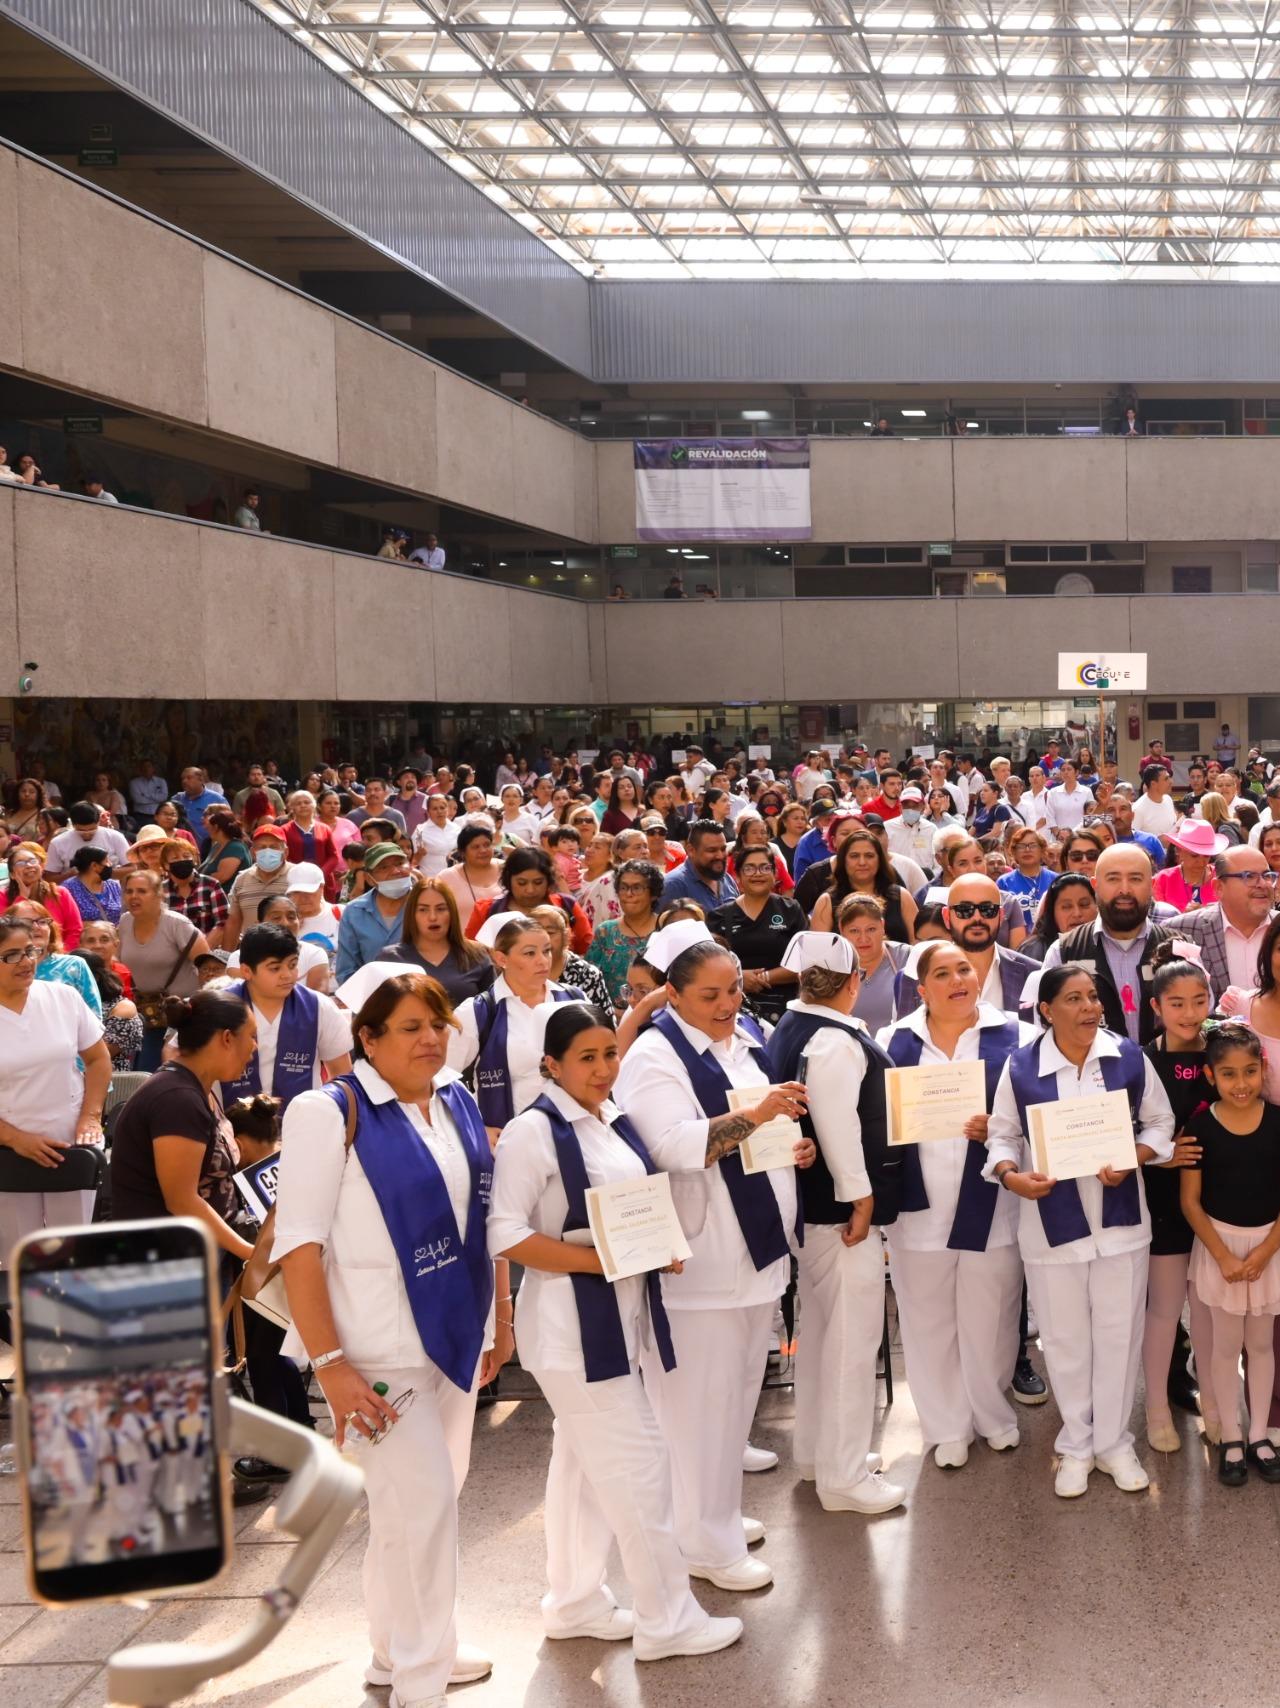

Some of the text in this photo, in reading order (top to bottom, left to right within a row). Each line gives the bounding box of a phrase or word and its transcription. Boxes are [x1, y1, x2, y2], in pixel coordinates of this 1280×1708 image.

[688, 448, 766, 458] REVALIDACIÓN
[922, 1087, 960, 1096] CONSTANCIA
[1066, 1119, 1105, 1130] CONSTANCIA
[621, 1206, 653, 1218] CONSTANCIA
